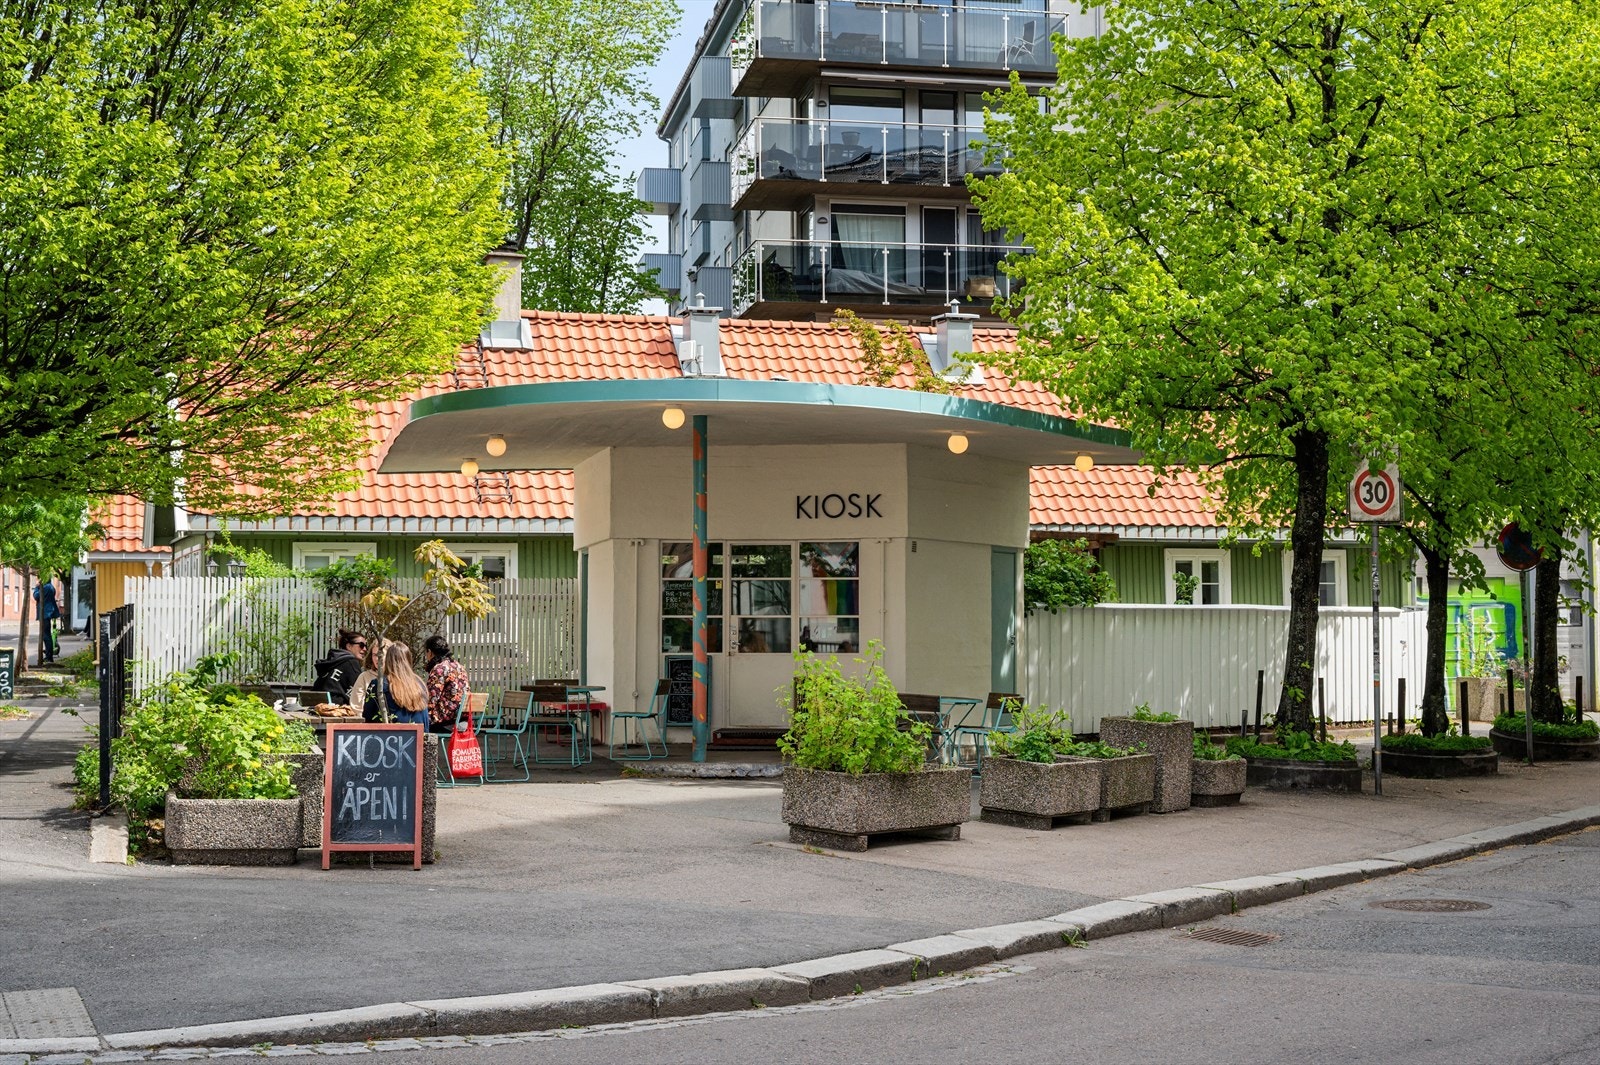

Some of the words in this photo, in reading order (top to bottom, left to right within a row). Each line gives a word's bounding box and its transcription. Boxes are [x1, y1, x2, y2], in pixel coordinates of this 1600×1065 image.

[1362, 480, 1388, 504] 30
[796, 493, 883, 519] KIOSK
[337, 734, 416, 769] KIOSK
[364, 772, 380, 783] er
